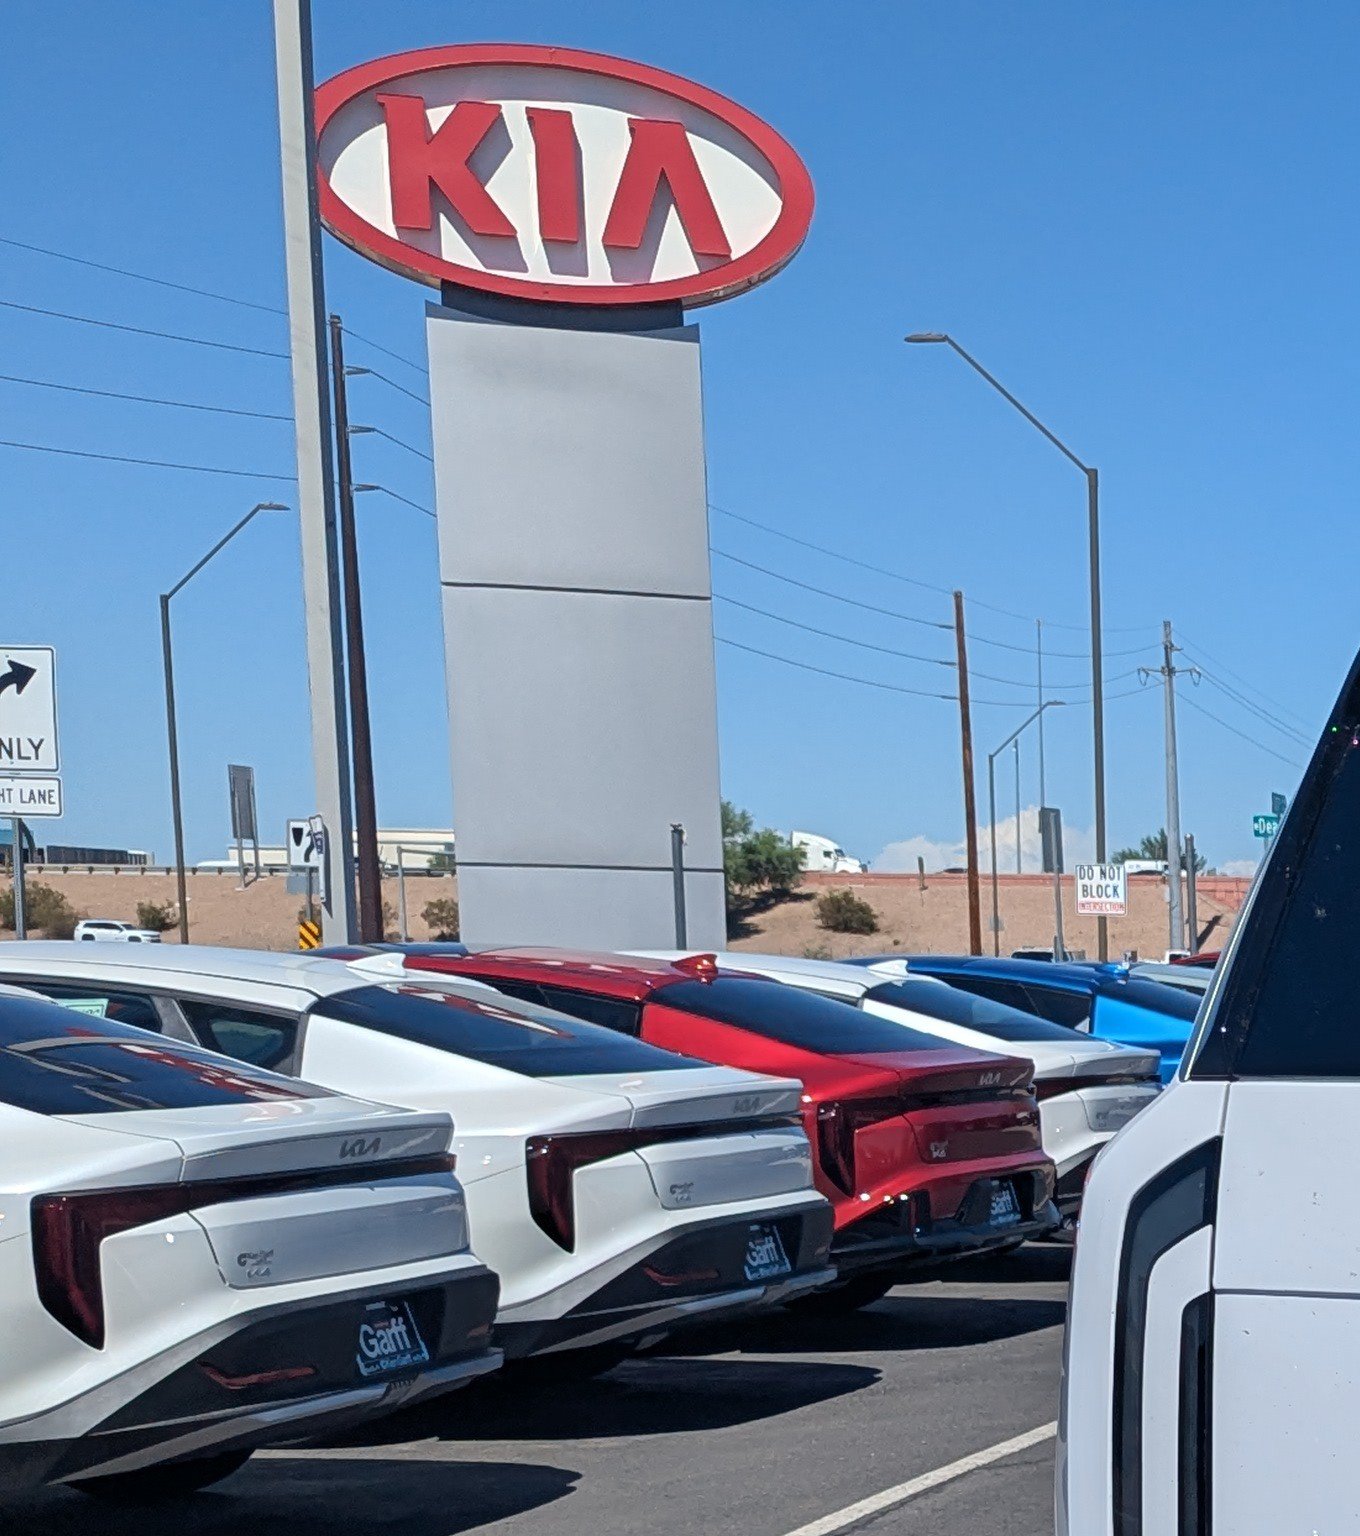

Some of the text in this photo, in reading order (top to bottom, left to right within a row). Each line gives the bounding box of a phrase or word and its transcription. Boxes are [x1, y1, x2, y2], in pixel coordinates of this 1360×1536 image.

[376, 93, 732, 256] KIA
[0, 737, 45, 761] NLY
[20, 788, 56, 805] LANE
[1079, 865, 1120, 881] DO NOT
[1082, 884, 1120, 899] BLOCK
[359, 1316, 412, 1359] Garff
